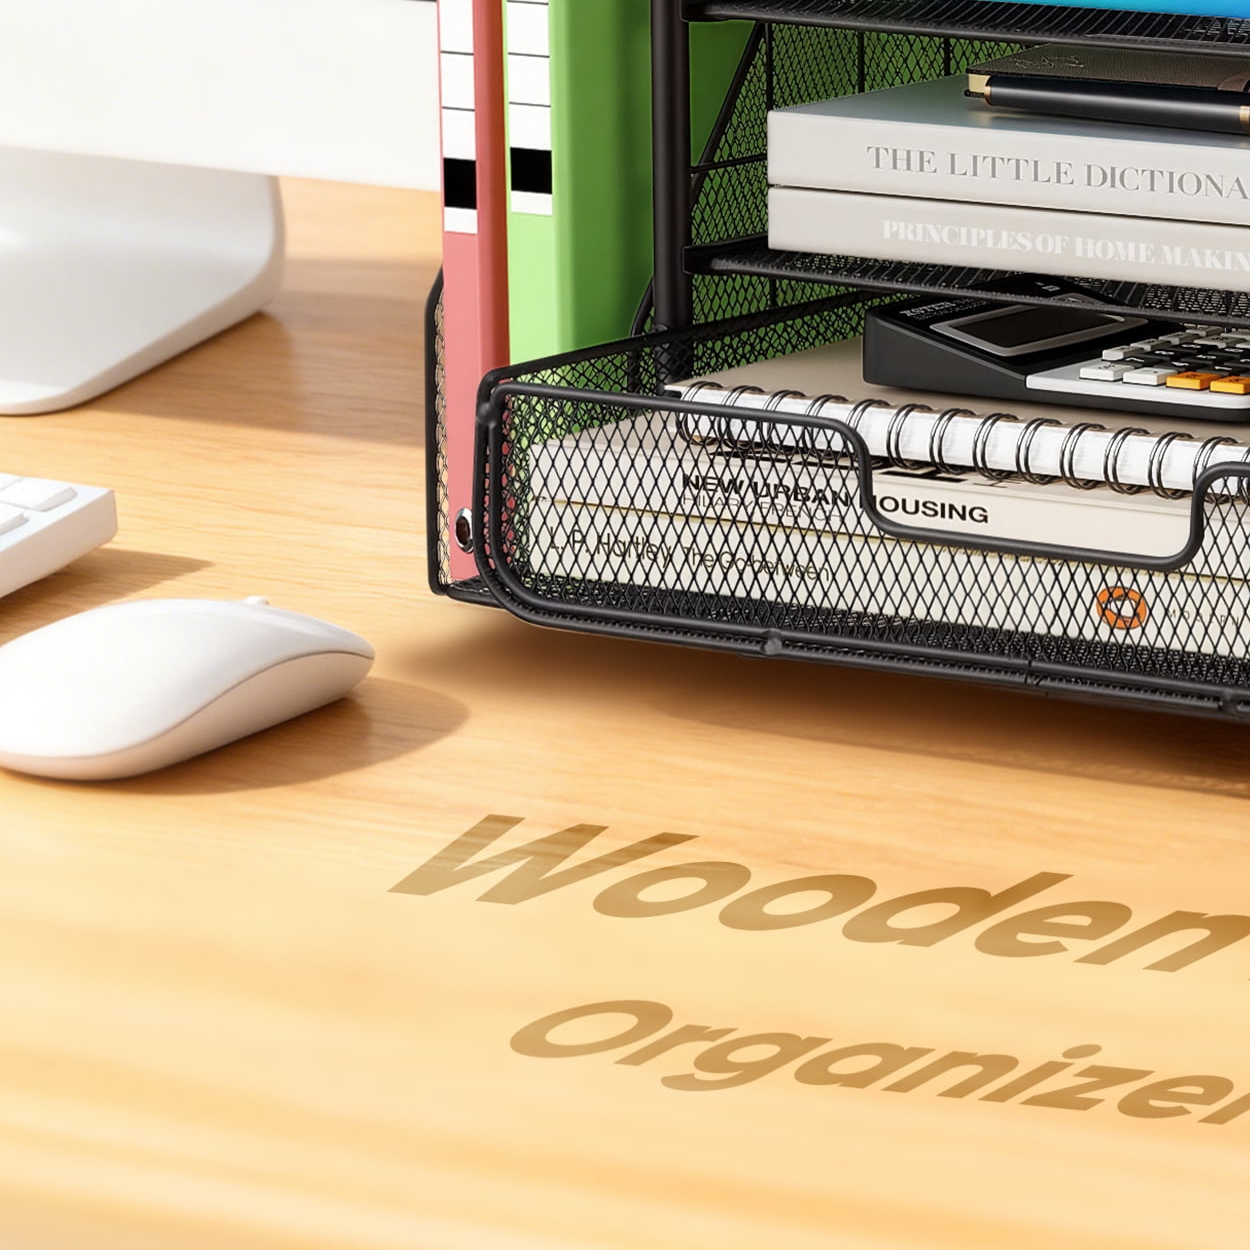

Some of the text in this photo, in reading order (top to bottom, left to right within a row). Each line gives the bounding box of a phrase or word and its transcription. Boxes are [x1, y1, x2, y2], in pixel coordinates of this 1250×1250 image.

[866, 146, 938, 174] THE
[949, 153, 1074, 185] LITTLE
[883, 220, 1034, 252] PRINCIPLES
[1034, 234, 1068, 255] OF
[1075, 237, 1156, 263] HOME
[682, 473, 745, 495] NEW
[753, 480, 850, 507] URBAN
[682, 494, 843, 521] HILARY FRENCH
[597, 532, 672, 569] Hartley
[683, 546, 715, 567] The
